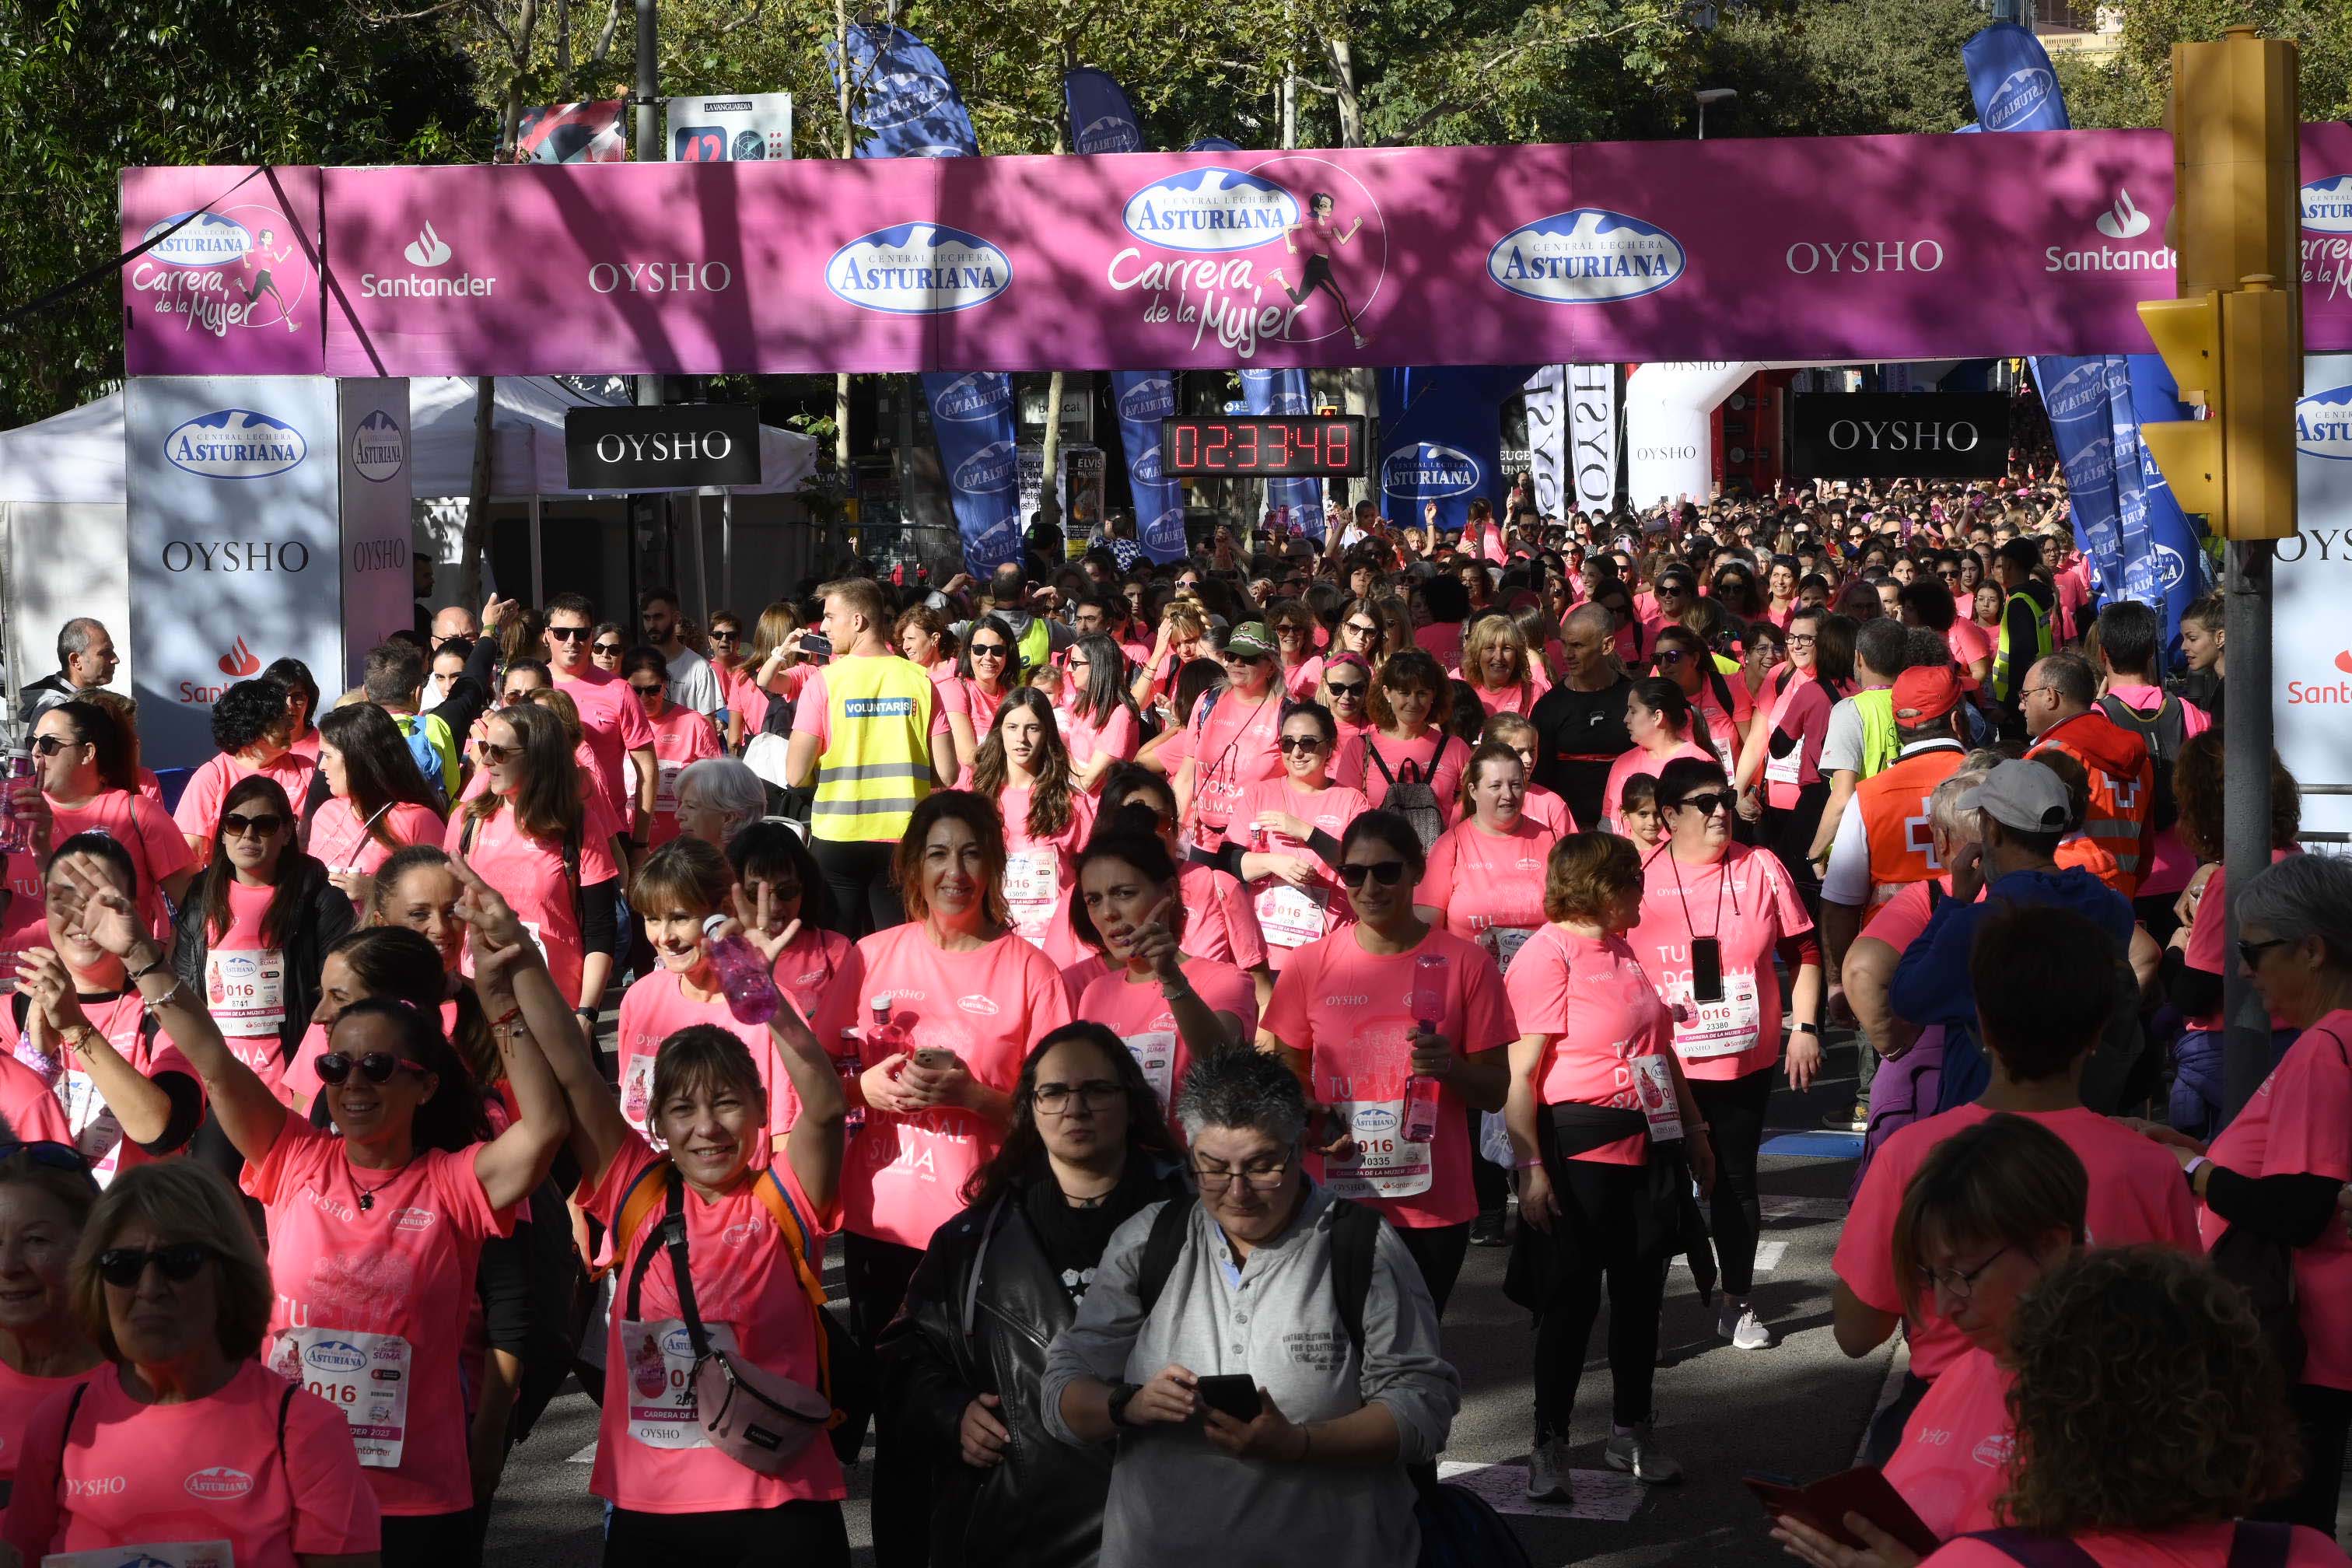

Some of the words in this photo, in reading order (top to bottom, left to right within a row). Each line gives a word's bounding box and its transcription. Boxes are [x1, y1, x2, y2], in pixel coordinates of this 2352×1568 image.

[1164, 196, 1220, 205] CENTRAL
[1224, 194, 1281, 205] LECHERA
[1136, 198, 1285, 231] ASTURIANA
[151, 231, 243, 252] ASTURIANA
[1533, 241, 1593, 253] CENTRAL
[1600, 240, 1664, 250] LECHERA
[868, 254, 928, 263] CENTRAL
[933, 253, 992, 262] LECHERA
[1502, 245, 1670, 281] ASTURIANA
[1786, 240, 1944, 275] OYSHO
[2045, 245, 2177, 271] Santand
[133, 263, 223, 292] Carrera
[589, 262, 731, 293] OYSHO
[841, 257, 997, 291] ASTURIANA
[1108, 247, 1251, 291] Carrera
[361, 273, 495, 298] Santander
[155, 292, 172, 313] de
[175, 292, 188, 313] la
[186, 289, 258, 337] Mujer
[1143, 291, 1171, 324] de
[1176, 291, 1196, 324] la
[1192, 286, 1307, 359] Mujer
[1829, 419, 1979, 452] OYSHO
[176, 435, 296, 462] ASTURIANA
[356, 441, 401, 466] ASTURIANA
[597, 430, 731, 463] OYSHO
[1175, 425, 1349, 467] 02:33:48
[1636, 446, 1696, 461] OYSHO
[1077, 458, 1102, 468] ELVIS
[1384, 470, 1473, 488] ASTURIANA
[162, 541, 309, 572] OYSHO
[353, 537, 405, 572] OYSHO
[845, 702, 910, 713] VOLUNTARIS
[1199, 796, 1234, 814] SUMA
[14, 880, 38, 896] TU
[1278, 905, 1301, 918] 016
[1657, 944, 1686, 964] TU
[226, 984, 254, 997] 016
[882, 989, 927, 1002] OYSHO
[1325, 995, 1369, 1006] OYSHO
[1702, 1007, 1731, 1020] 016
[1706, 1022, 1729, 1031] 23380
[233, 1046, 269, 1066] MA
[1684, 1045, 1710, 1054] OYSHO
[1330, 1076, 1353, 1099] TU
[1355, 1118, 1395, 1127] ASTURIANA
[1357, 1139, 1394, 1153] 016
[870, 1138, 935, 1174] SUMA
[1391, 1181, 1425, 1189] Santander
[278, 1294, 308, 1328] TU
[309, 1349, 362, 1367] ASTURIANA
[373, 1352, 401, 1361] SUMA
[309, 1381, 357, 1403] 016
[644, 1410, 677, 1419] CARRERA
[370, 1429, 391, 1437] 2023
[640, 1428, 680, 1440] OYSHO
[190, 1476, 250, 1492] ASTURIANA
